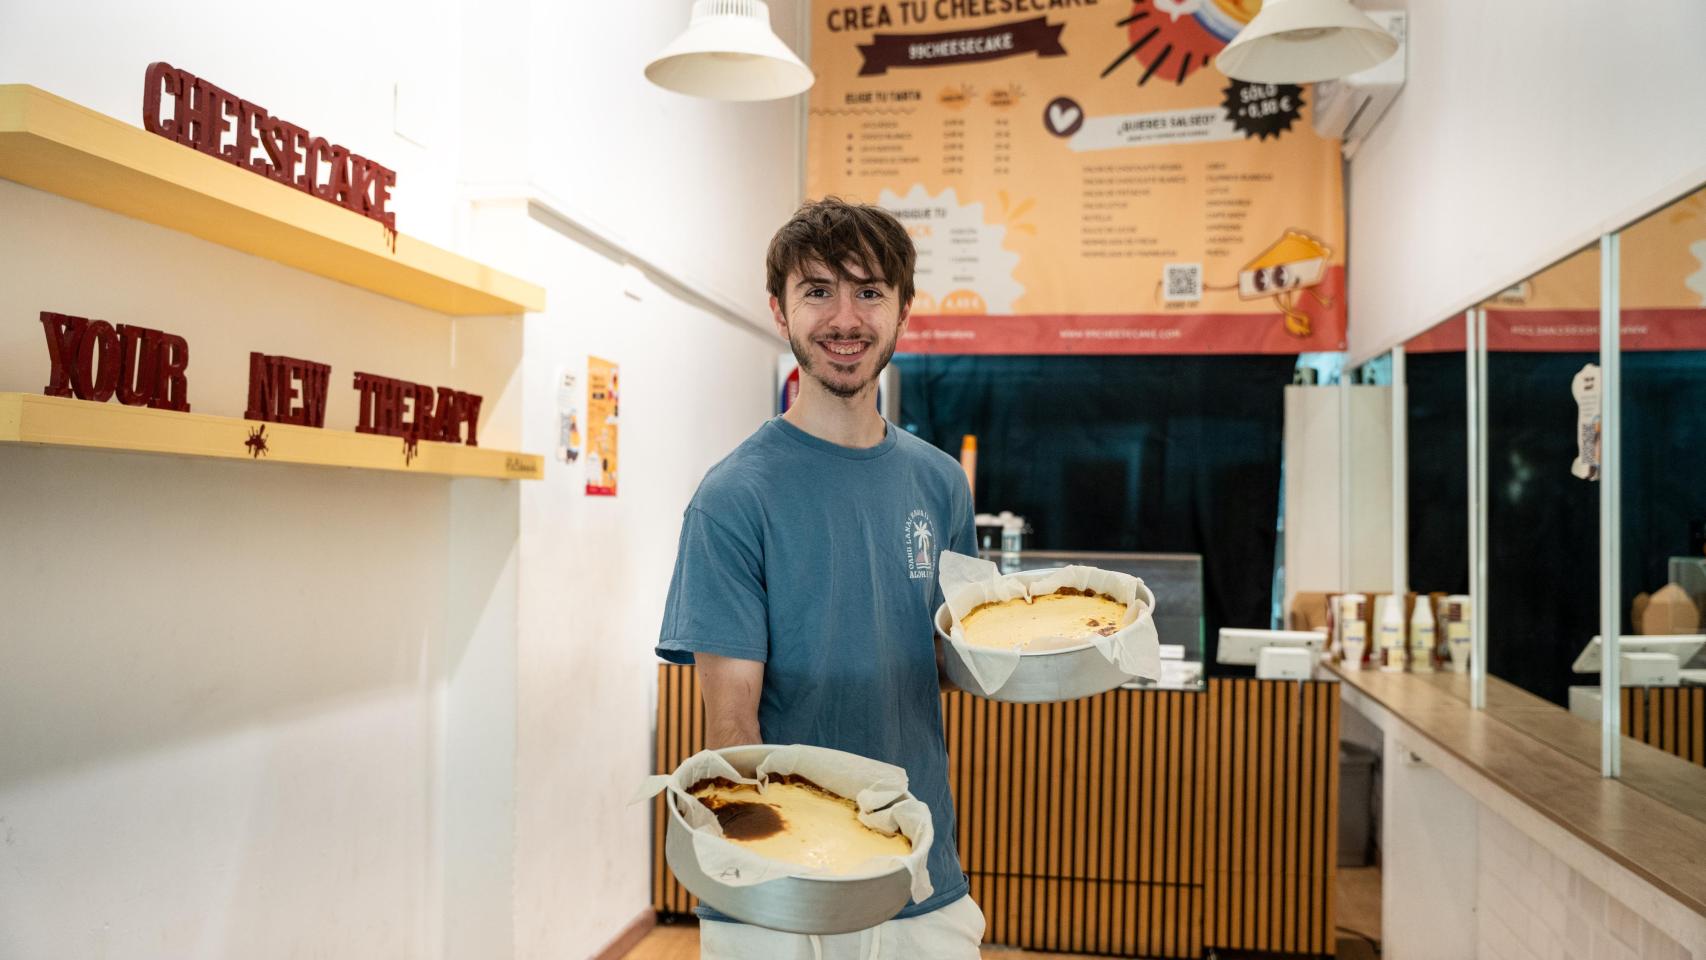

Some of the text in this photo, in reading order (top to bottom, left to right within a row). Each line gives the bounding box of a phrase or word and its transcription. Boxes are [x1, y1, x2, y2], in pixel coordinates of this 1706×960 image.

[827, 0, 1099, 32] CREA TU CHEESEC
[908, 32, 1014, 60] 99CHEESECAKE
[143, 62, 397, 233] CHEESECAKE
[40, 311, 483, 447] YOUR NEW THERAPY
